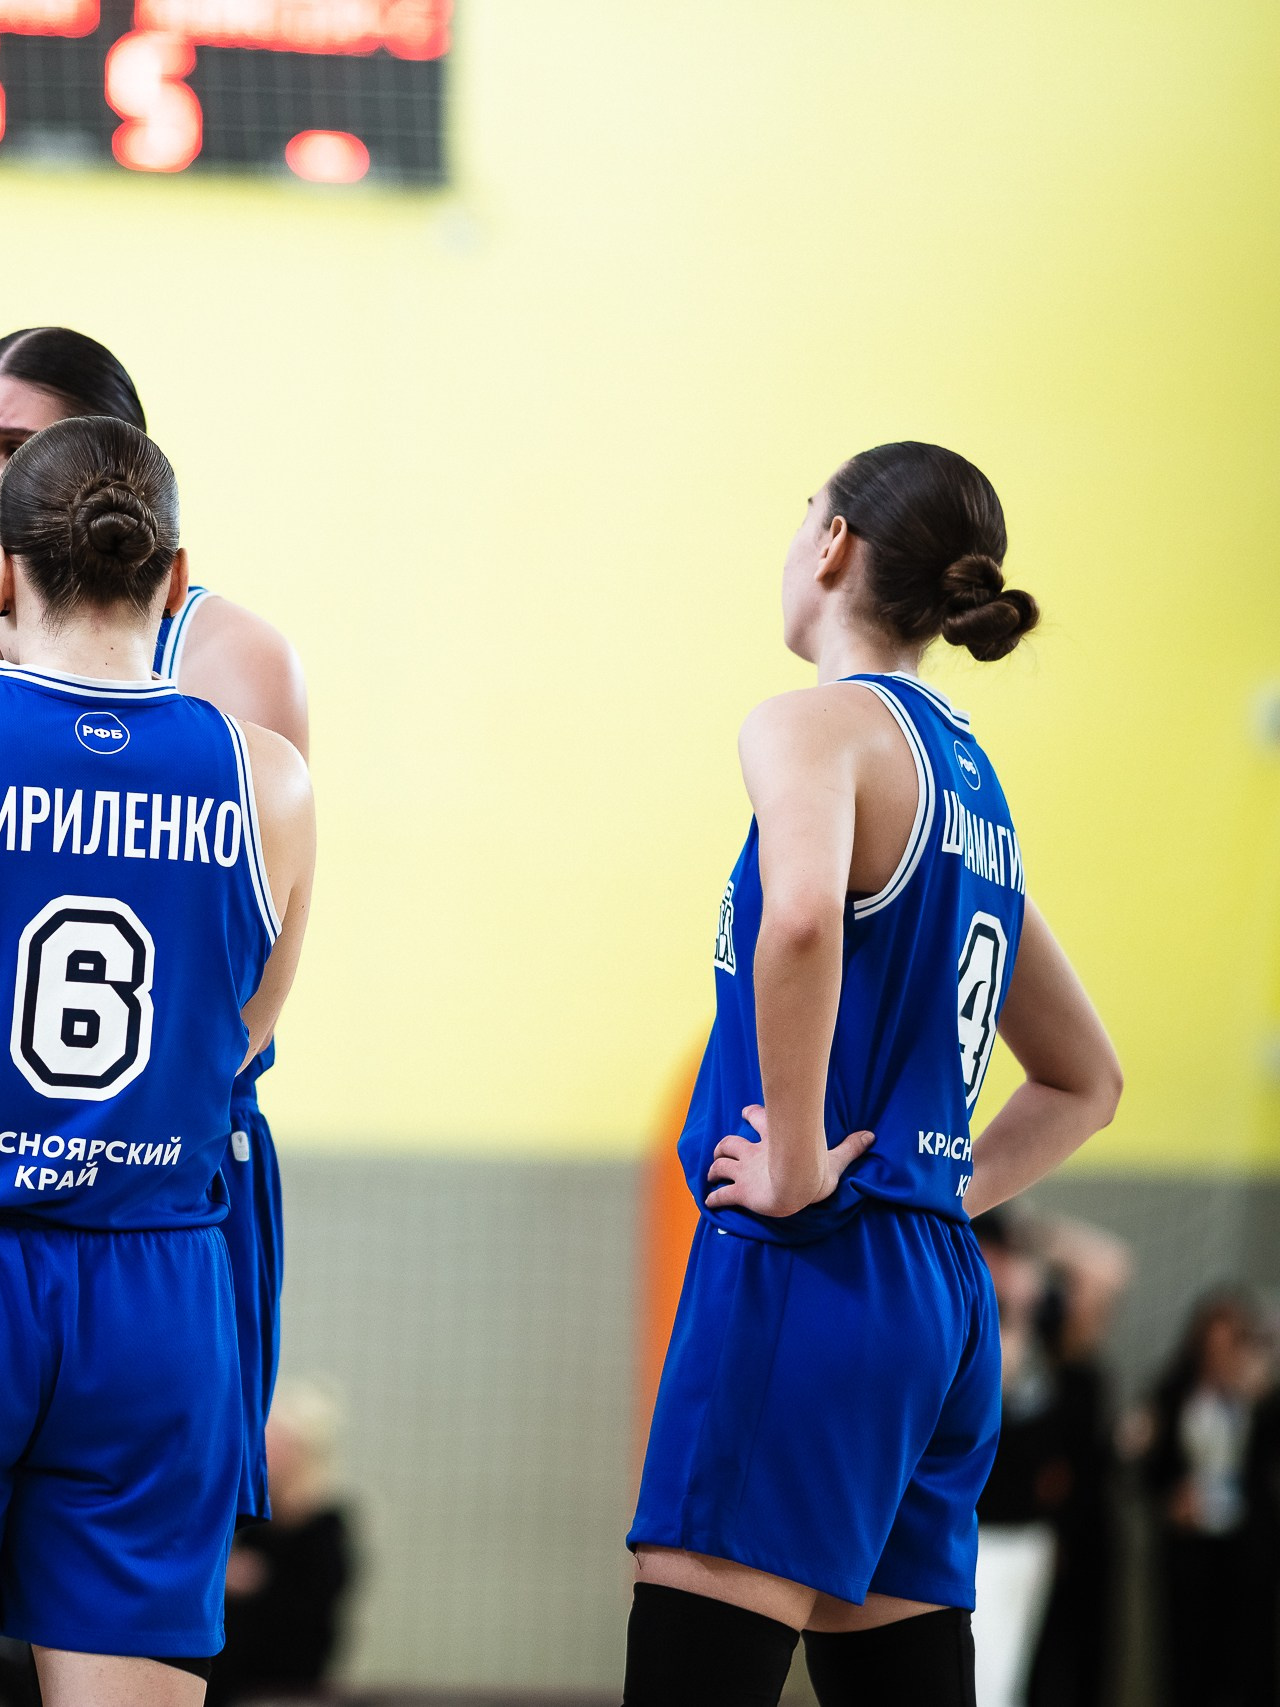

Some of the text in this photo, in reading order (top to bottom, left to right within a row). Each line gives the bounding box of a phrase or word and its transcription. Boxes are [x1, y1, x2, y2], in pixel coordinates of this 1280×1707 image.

[82, 724, 124, 740] РФБ
[9, 893, 156, 1102] 6
[917, 1130, 973, 1163] КРАСН
[14, 1161, 99, 1192] КРАЙ
